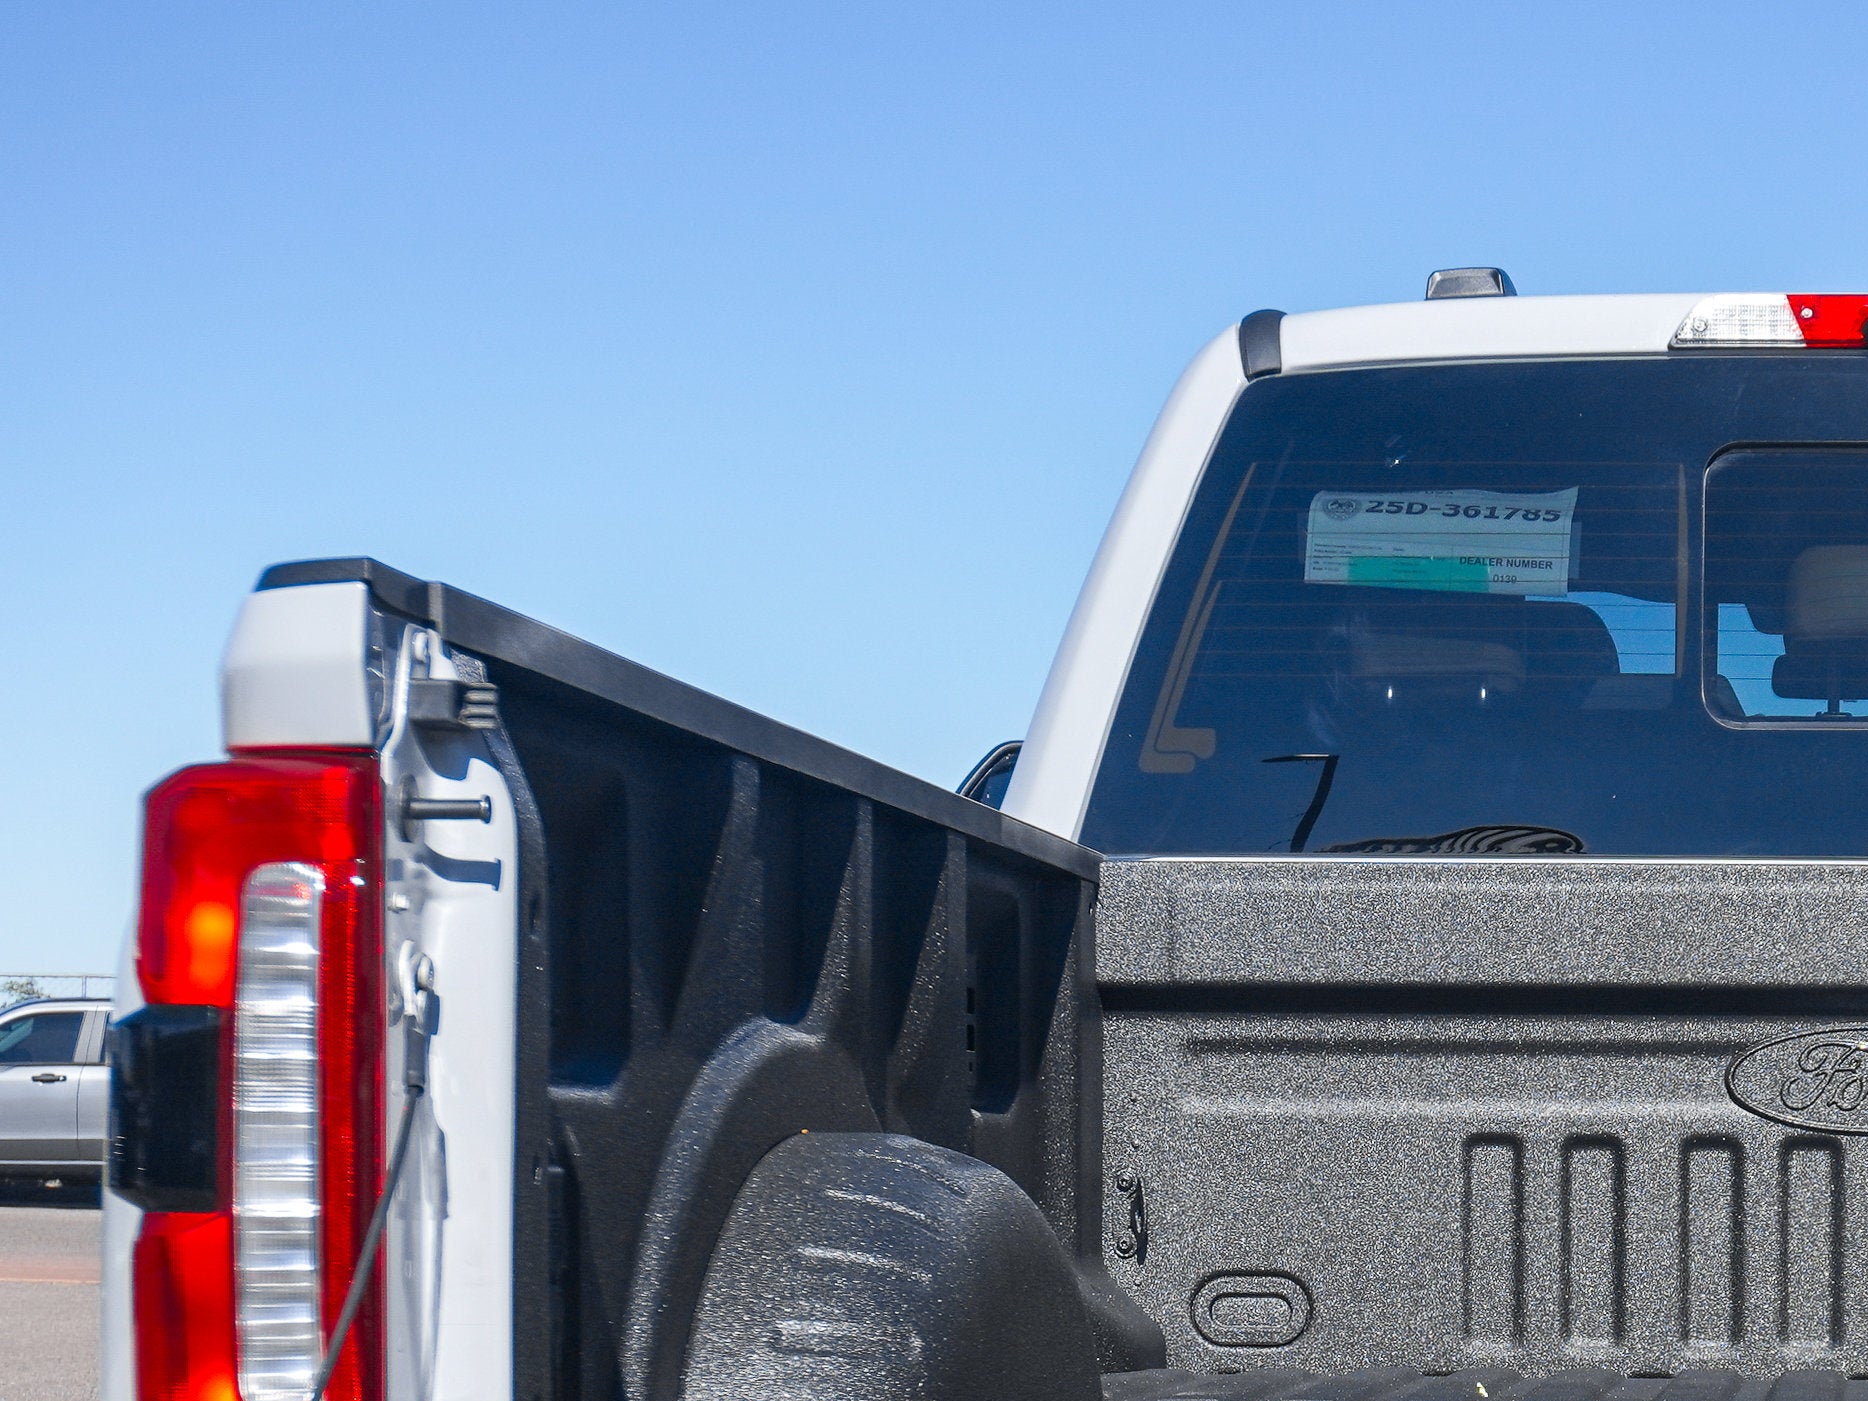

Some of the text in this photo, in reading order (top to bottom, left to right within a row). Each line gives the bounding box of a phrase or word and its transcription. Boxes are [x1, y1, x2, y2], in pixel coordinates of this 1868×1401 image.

[1365, 500, 1562, 522] 25D-361785
[1459, 556, 1553, 570] DEALER NUMBER
